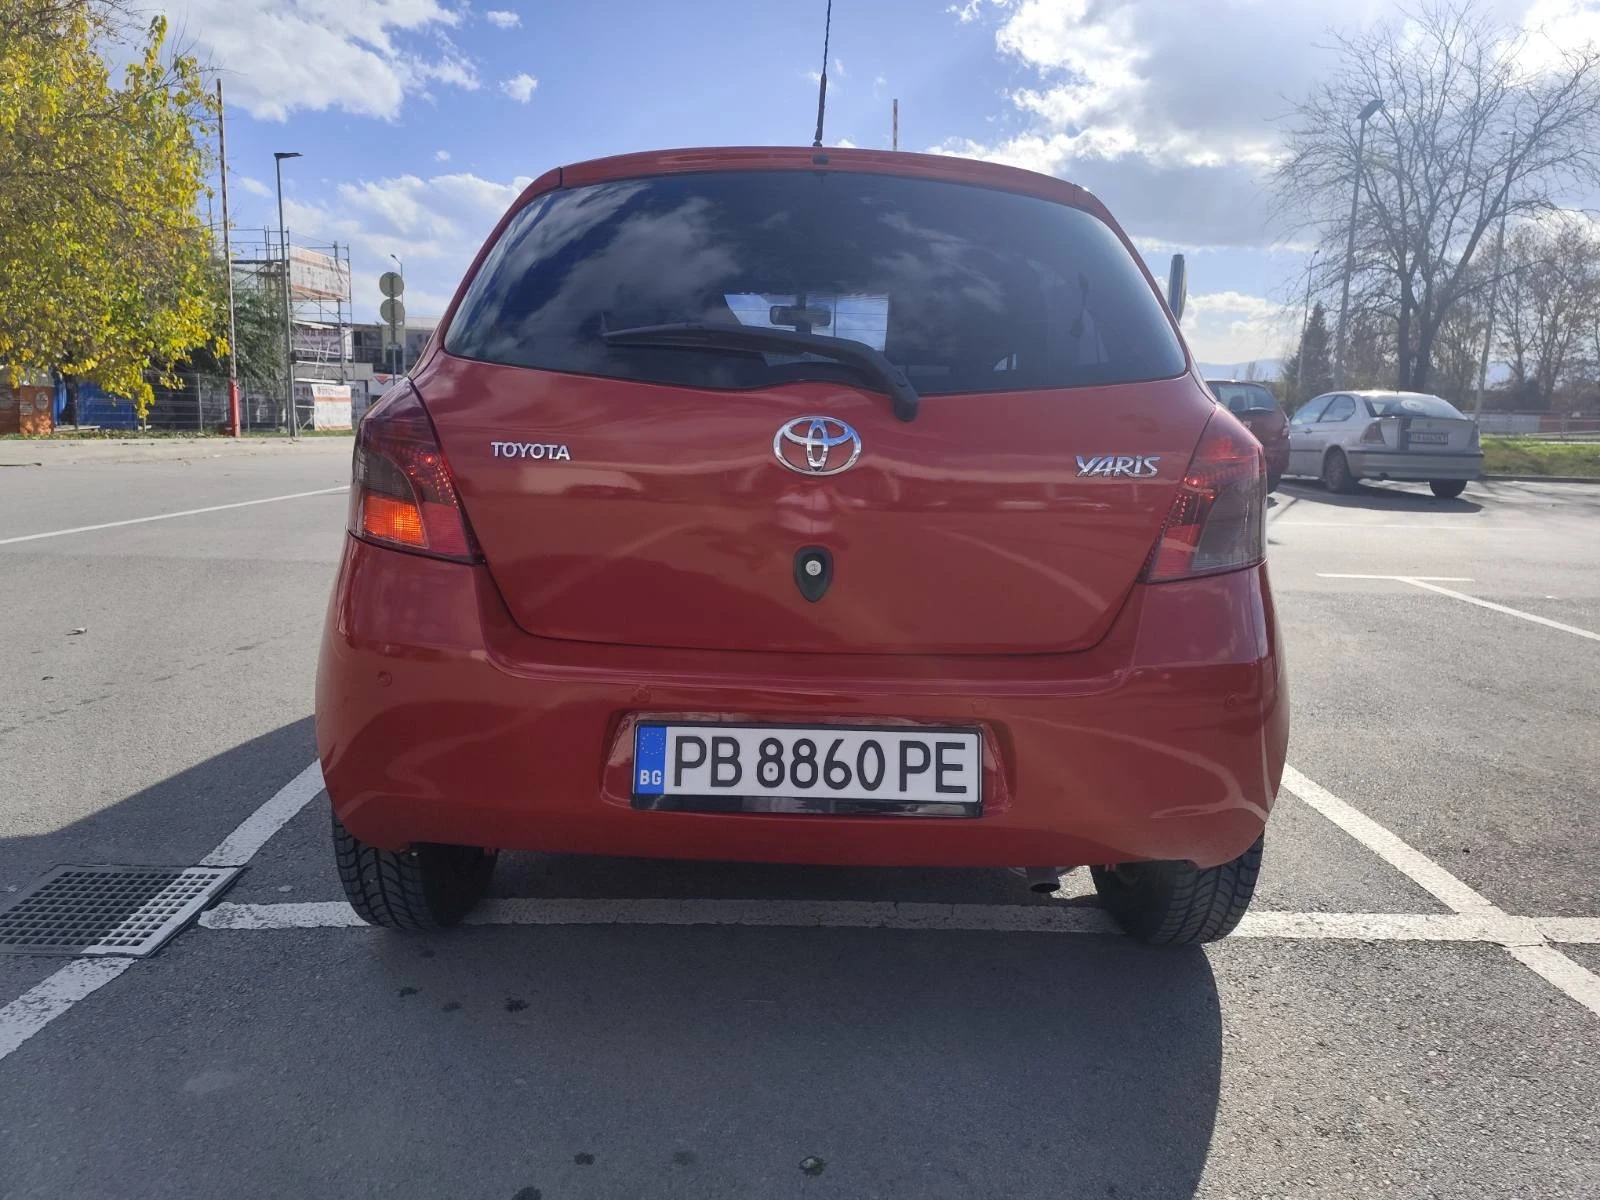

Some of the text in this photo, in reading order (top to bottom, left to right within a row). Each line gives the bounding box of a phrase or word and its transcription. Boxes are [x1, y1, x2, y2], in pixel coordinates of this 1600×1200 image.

[491, 441, 571, 460] TOYOTA
[673, 735, 967, 794] PB 8860 PE
[640, 769, 662, 785] BG
